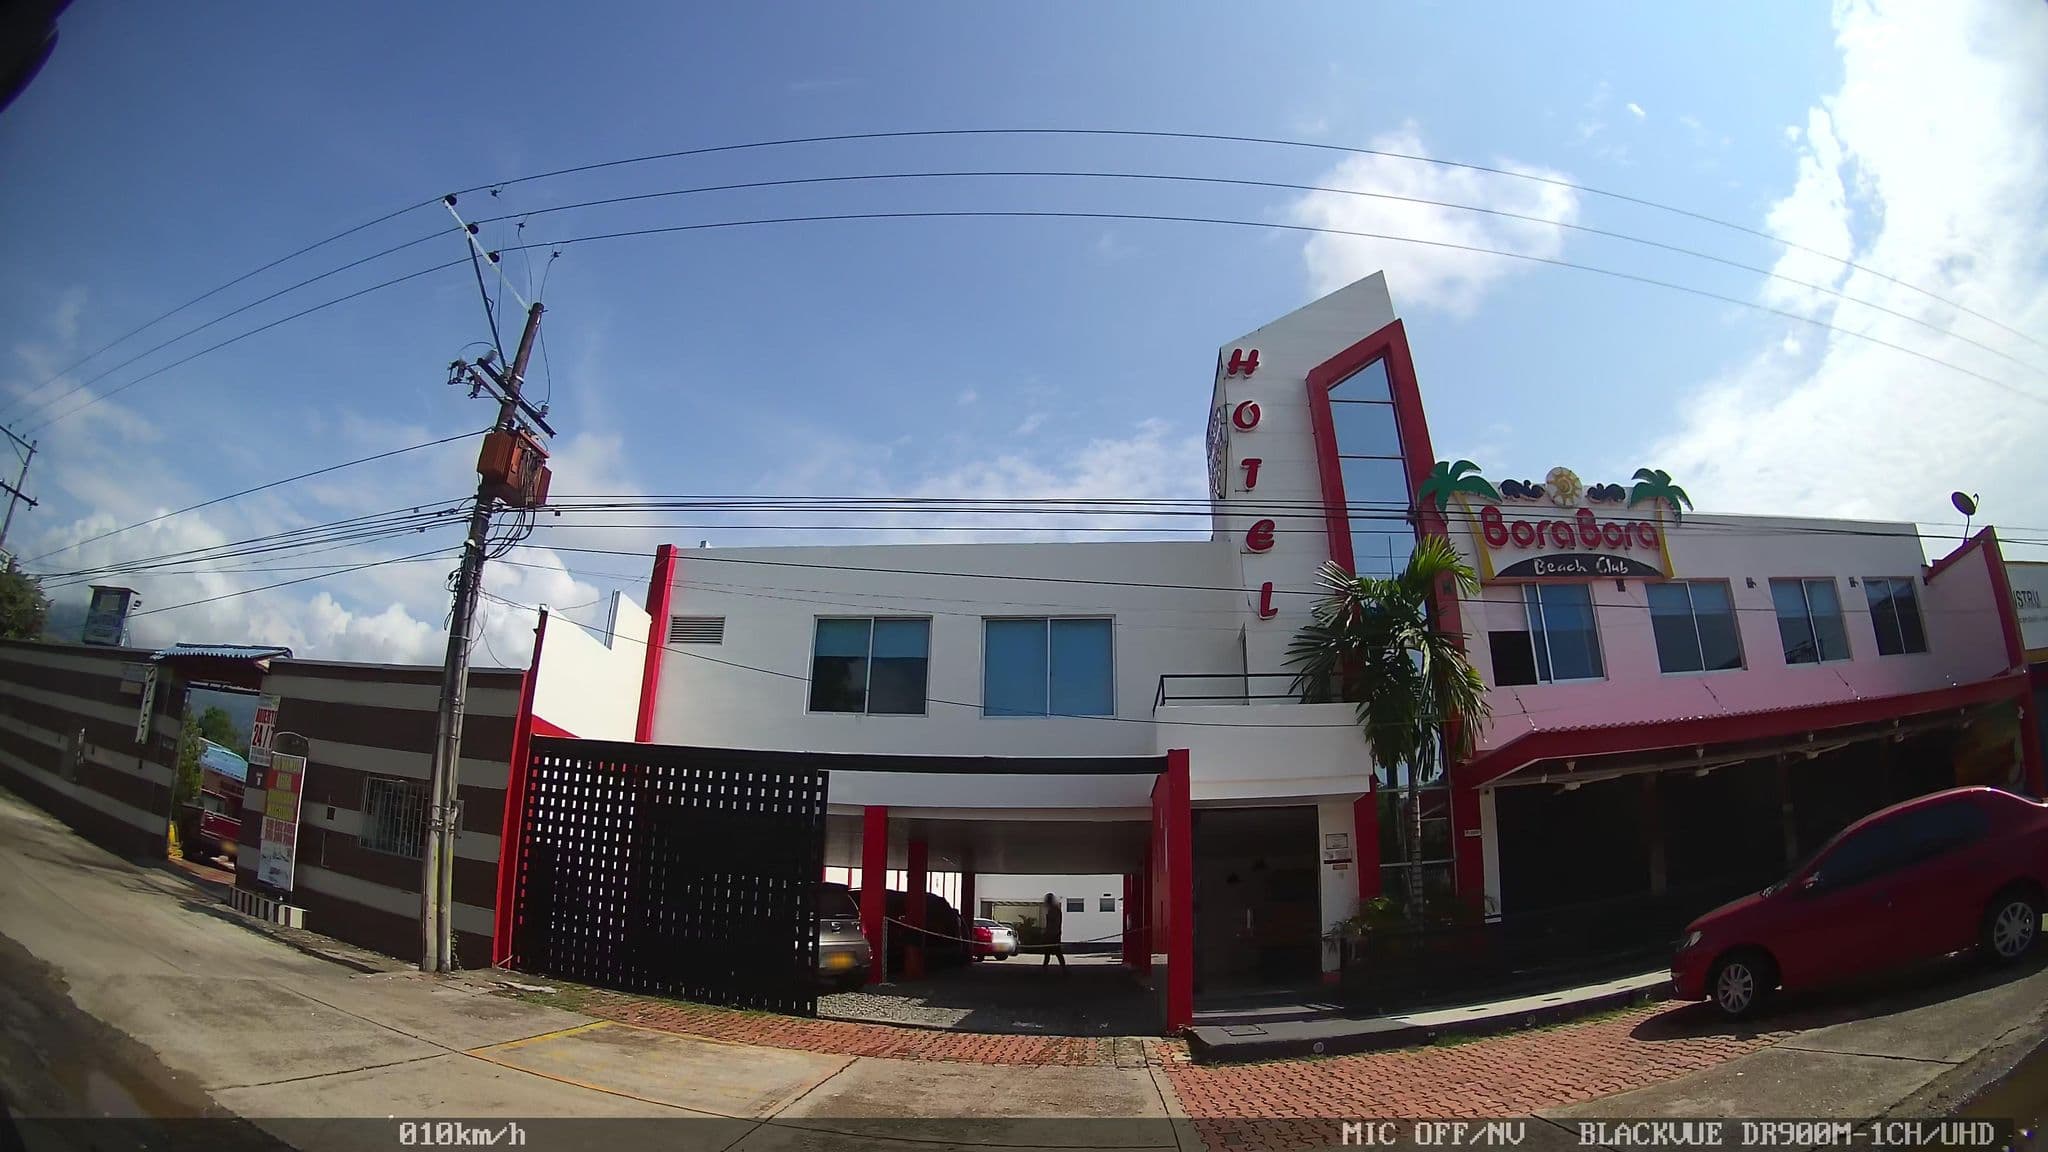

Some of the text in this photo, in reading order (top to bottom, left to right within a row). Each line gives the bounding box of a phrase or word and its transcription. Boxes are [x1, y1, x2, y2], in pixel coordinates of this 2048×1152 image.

[1227, 347, 1279, 620] HOTEL
[1533, 557, 1629, 575] Beach Club
